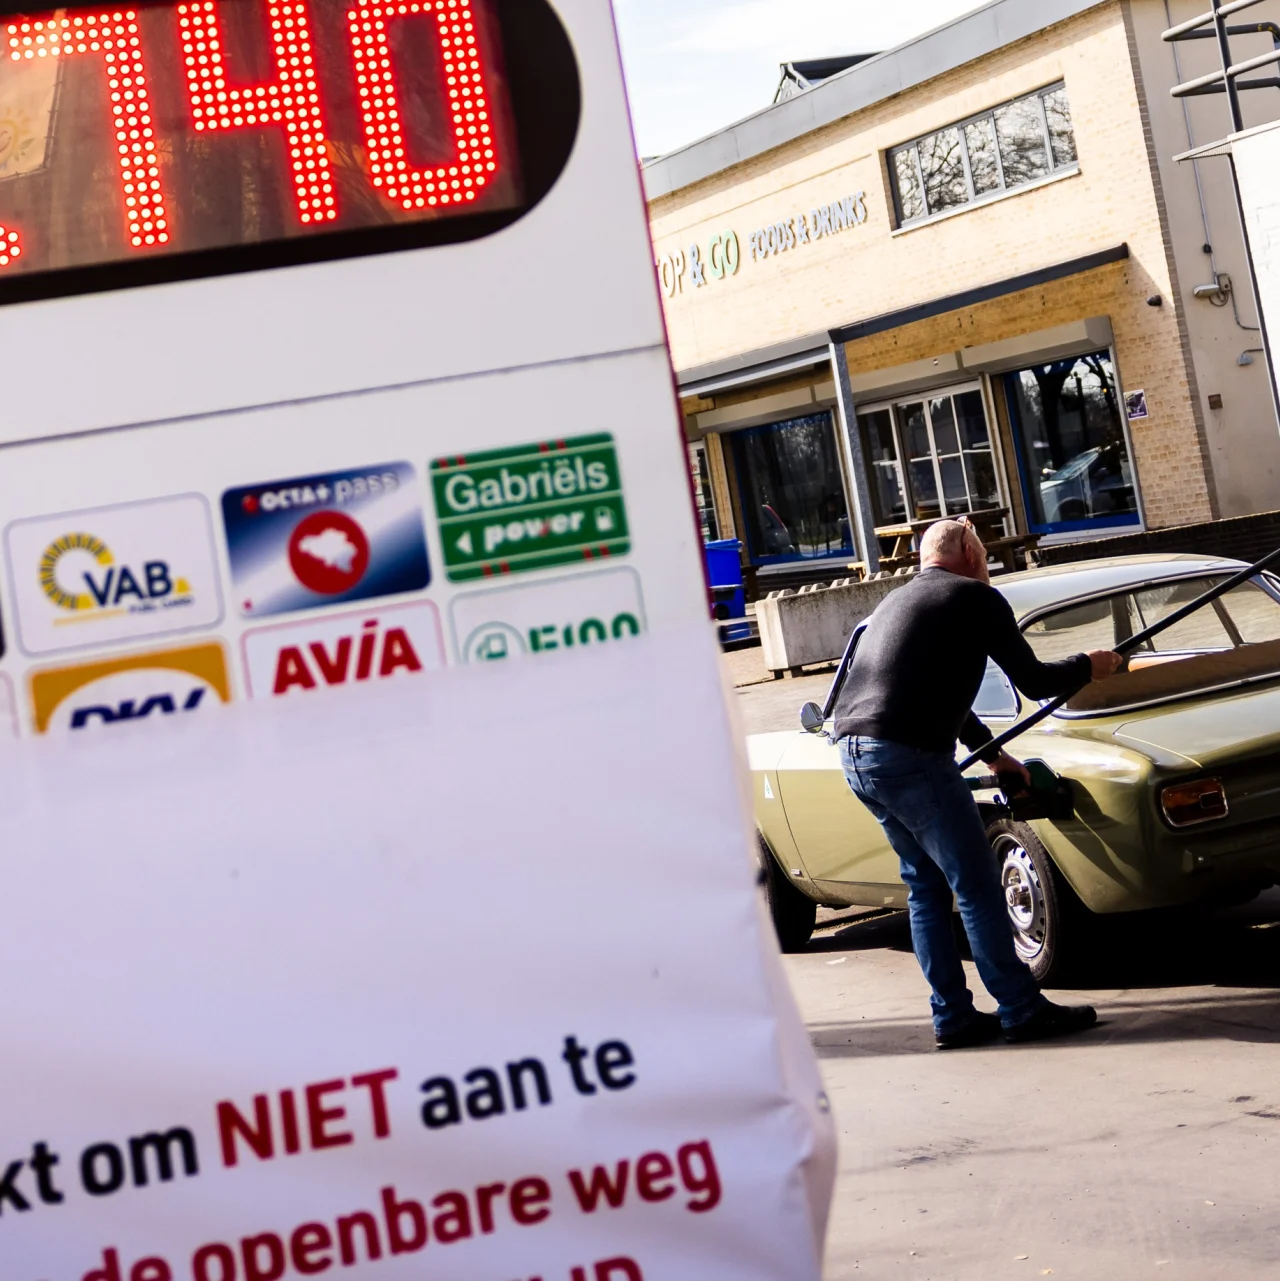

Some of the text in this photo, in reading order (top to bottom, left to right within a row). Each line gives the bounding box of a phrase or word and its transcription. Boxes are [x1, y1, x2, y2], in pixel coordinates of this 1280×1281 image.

[708, 228, 741, 280] GO
[748, 216, 797, 262] FOODS
[796, 213, 811, 245] &
[810, 189, 869, 240] DRINKS
[335, 472, 400, 506] pass
[444, 455, 610, 513] Gabriëls
[483, 506, 586, 552] power
[83, 560, 174, 607] VAB
[81, 1123, 200, 1199] om
[214, 1067, 402, 1169] NIET
[418, 1051, 553, 1130] aan
[563, 1033, 638, 1096] te
[191, 1185, 550, 1281] openbare
[567, 1138, 724, 1212] weg
